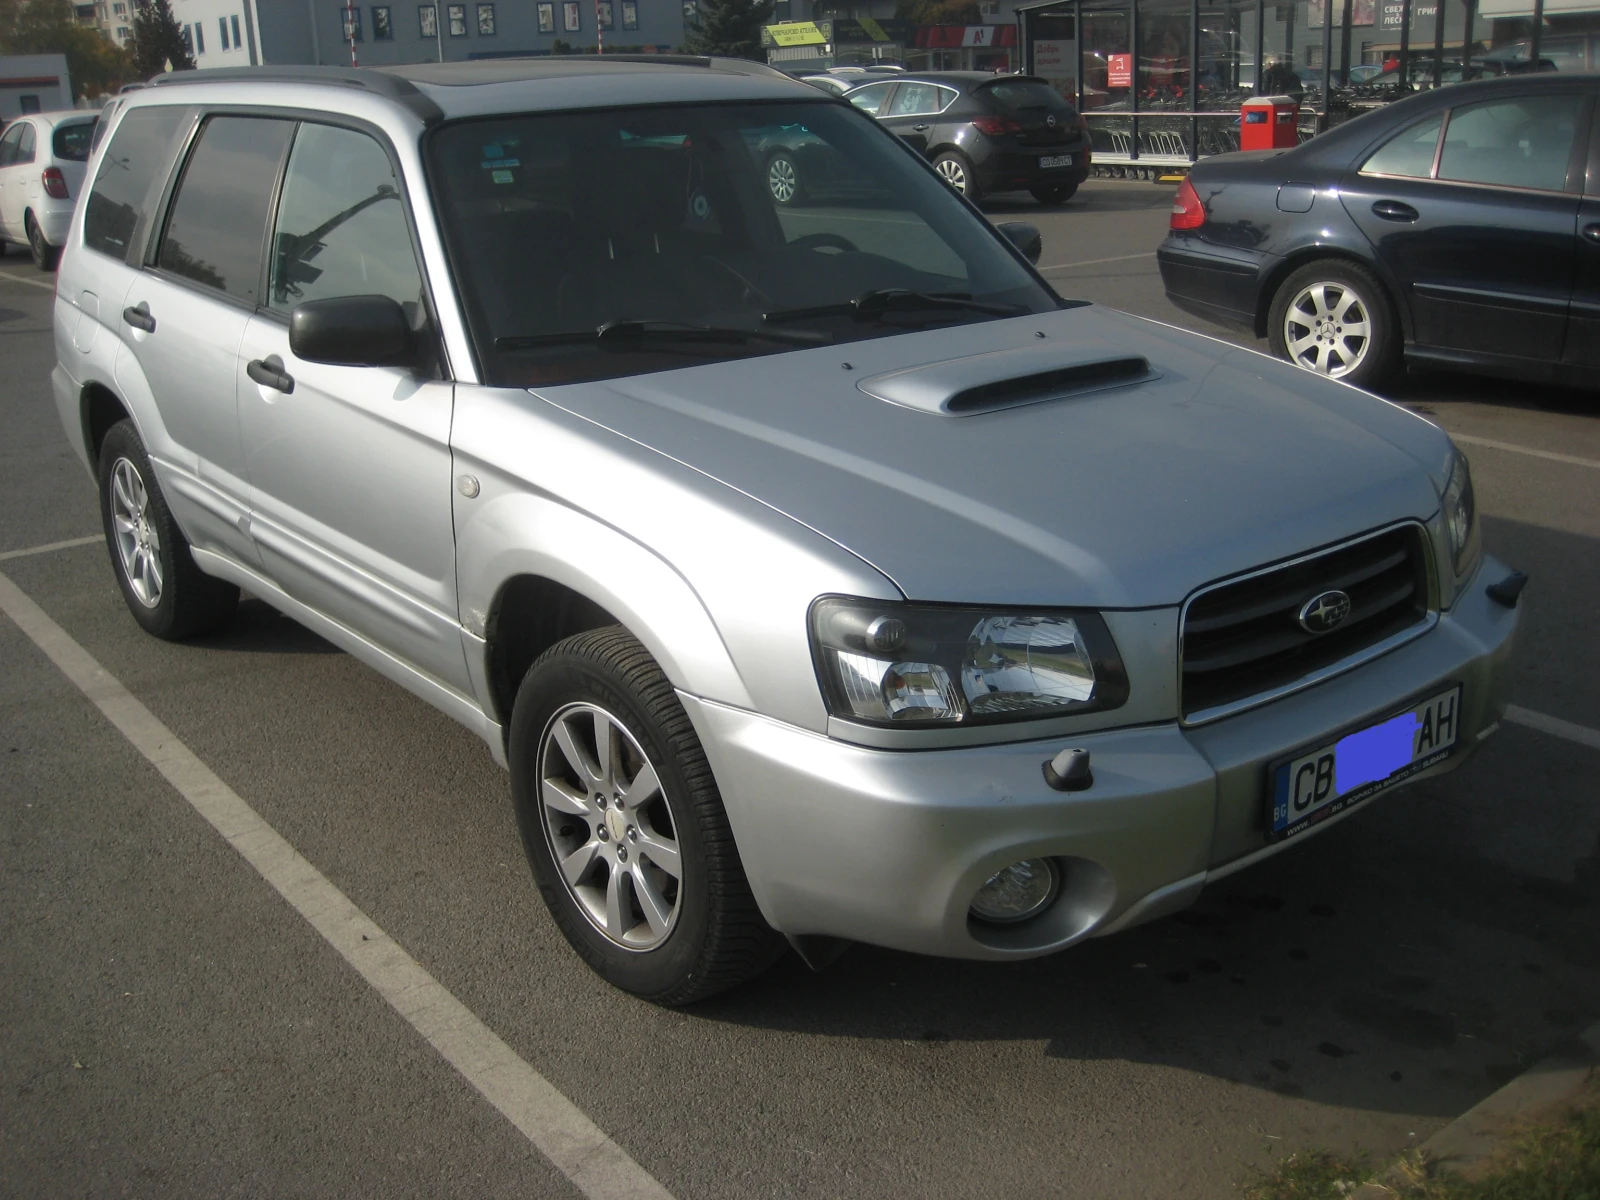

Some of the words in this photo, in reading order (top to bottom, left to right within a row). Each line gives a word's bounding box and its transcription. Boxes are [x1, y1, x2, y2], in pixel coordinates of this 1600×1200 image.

[973, 29, 984, 44] A1
[1423, 751, 1449, 768] SUBARU
[1273, 803, 1287, 821] BG
